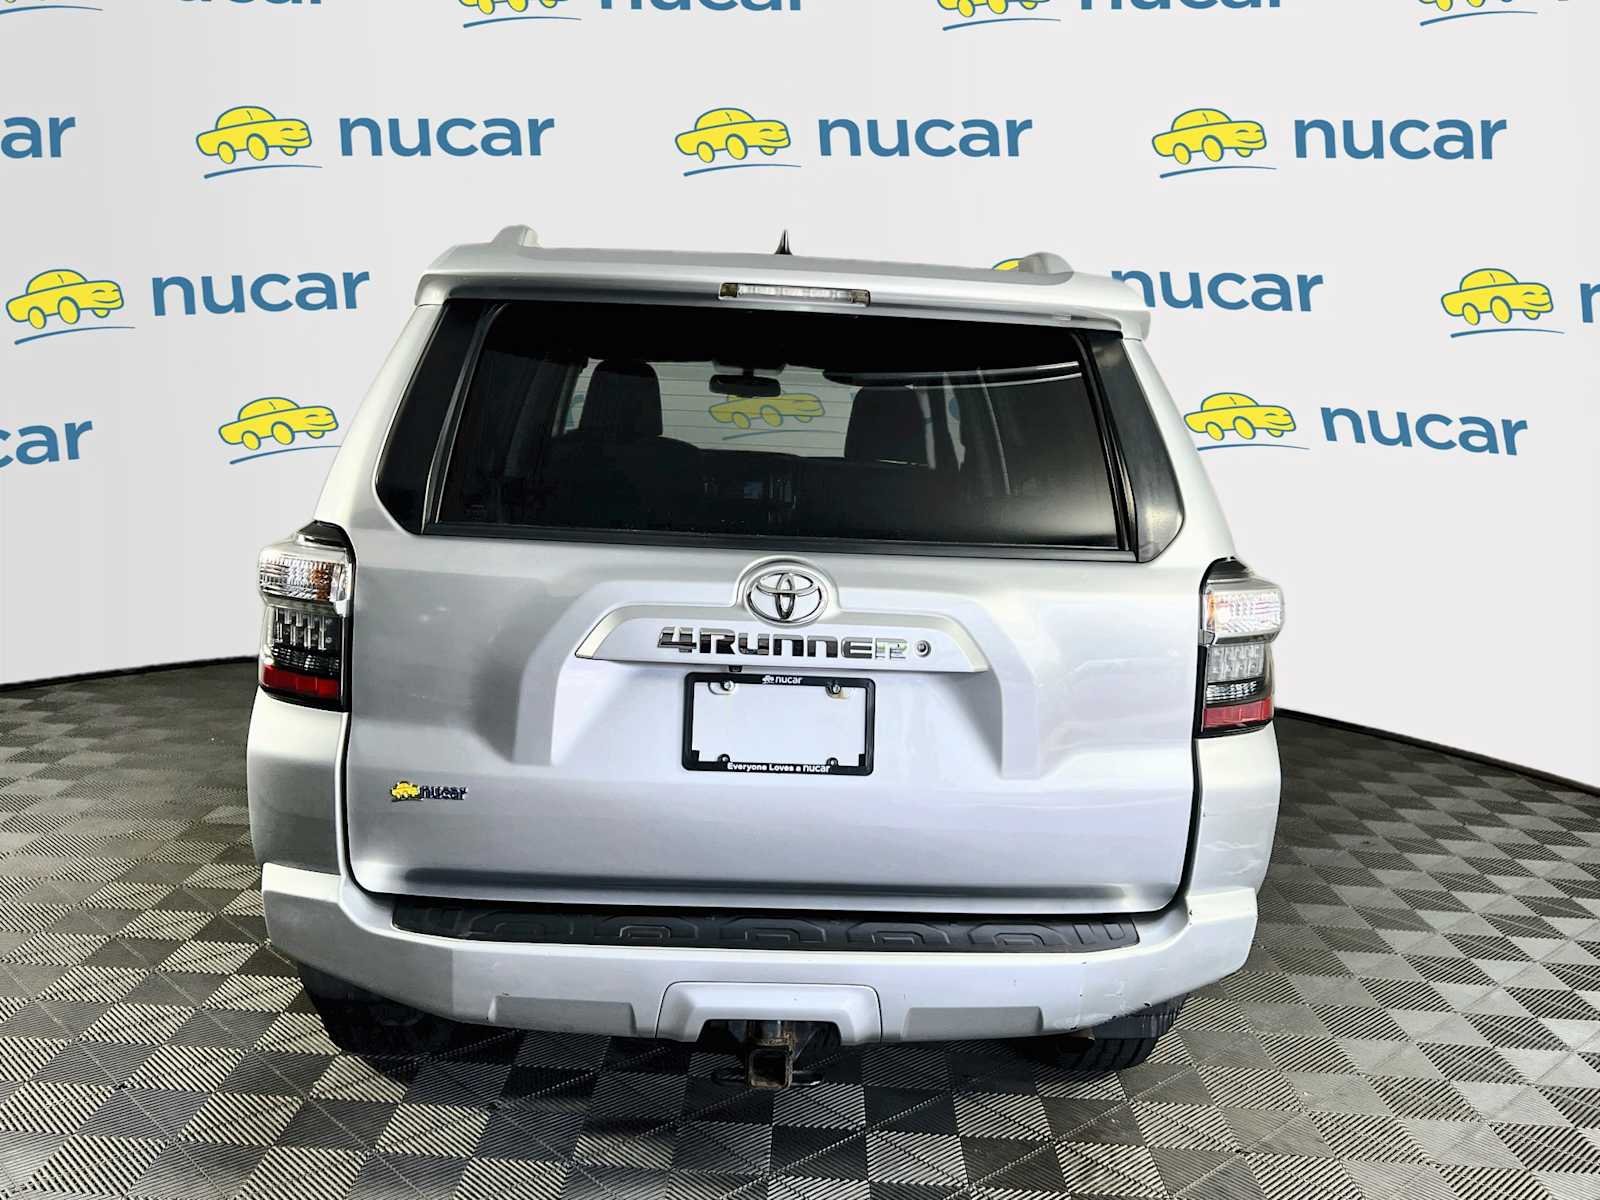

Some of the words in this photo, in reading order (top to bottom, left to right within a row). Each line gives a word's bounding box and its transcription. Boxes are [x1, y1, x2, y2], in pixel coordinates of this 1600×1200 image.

[339, 116, 556, 157] nucar
[818, 118, 1034, 158] nucar
[1294, 118, 1509, 161] nucar
[151, 271, 370, 317] nucar
[1110, 270, 1324, 313] nucar
[1320, 406, 1529, 457] nucar
[775, 676, 803, 685] nucar
[727, 762, 768, 772] Everyone
[768, 764, 794, 772] Loves
[802, 764, 831, 773] nucar
[420, 785, 467, 801] nucar
